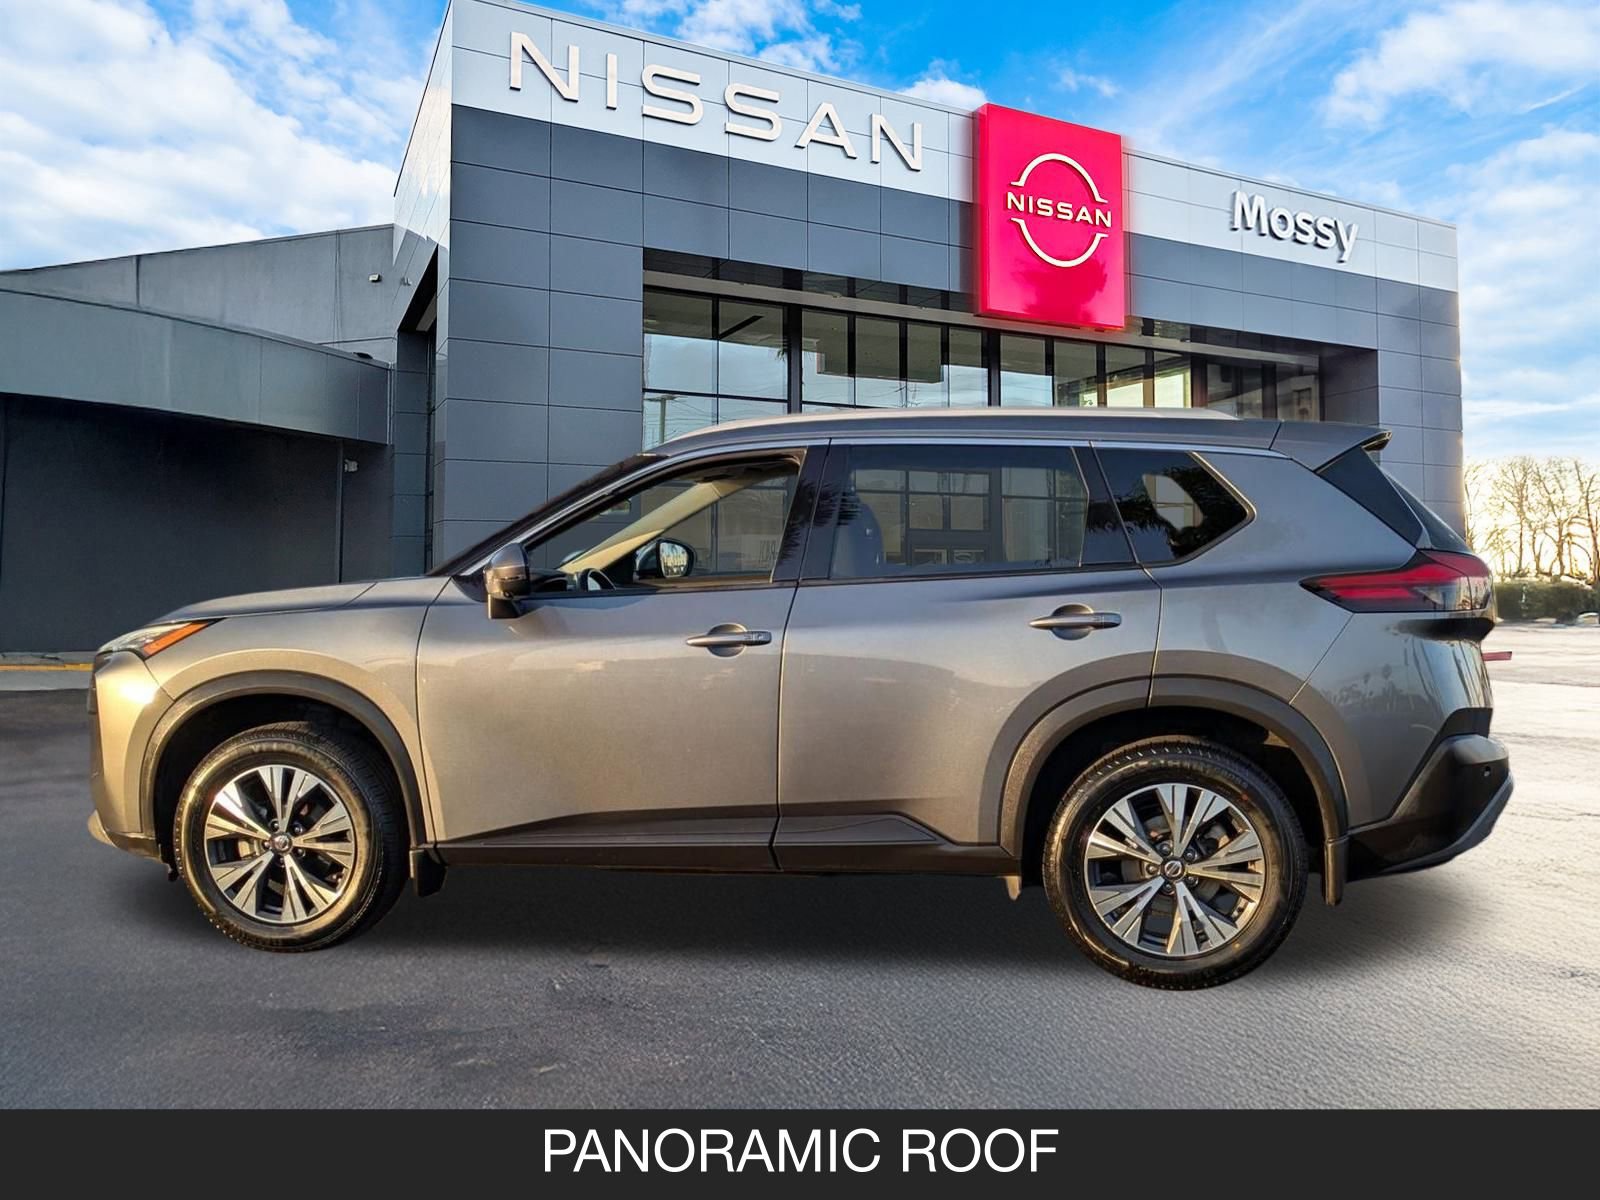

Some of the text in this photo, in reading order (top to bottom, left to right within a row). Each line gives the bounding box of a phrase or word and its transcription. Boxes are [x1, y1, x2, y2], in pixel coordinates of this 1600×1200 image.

[510, 31, 922, 172] NISSAN
[1007, 191, 1112, 228] NISSAN
[1231, 190, 1359, 263] Mossy
